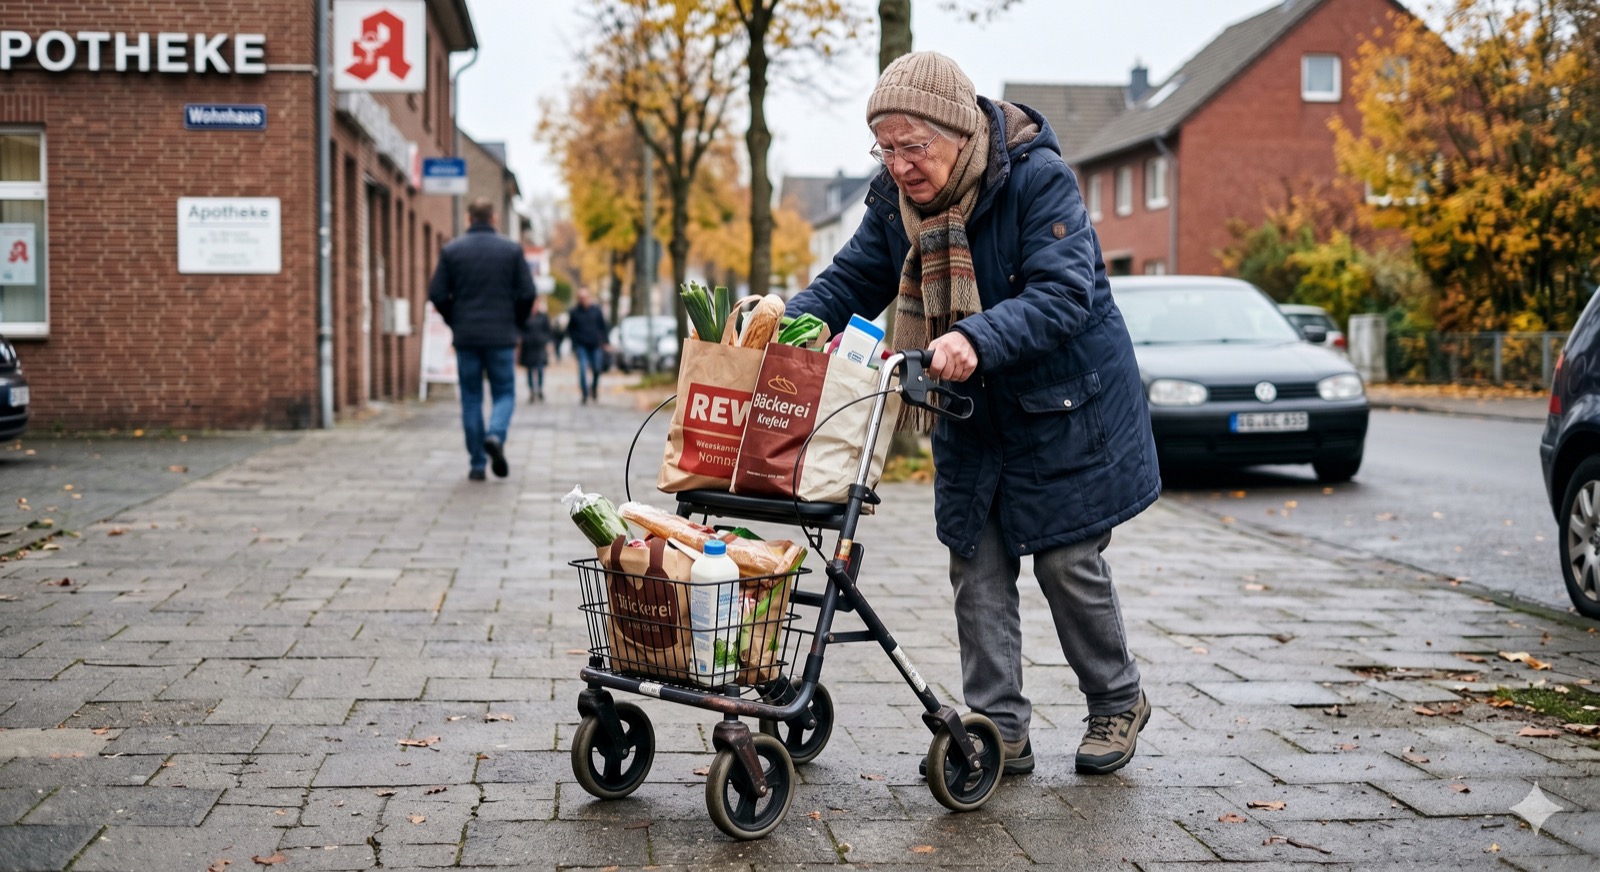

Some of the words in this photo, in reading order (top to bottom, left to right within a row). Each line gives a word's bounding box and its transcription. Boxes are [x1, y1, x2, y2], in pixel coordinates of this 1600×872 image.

[0, 30, 267, 74] POTHEKE
[188, 106, 262, 124] Wohnhaus
[188, 204, 270, 222] Apotheke
[753, 393, 811, 418] Bäckerei
[757, 412, 790, 429] Krefeld
